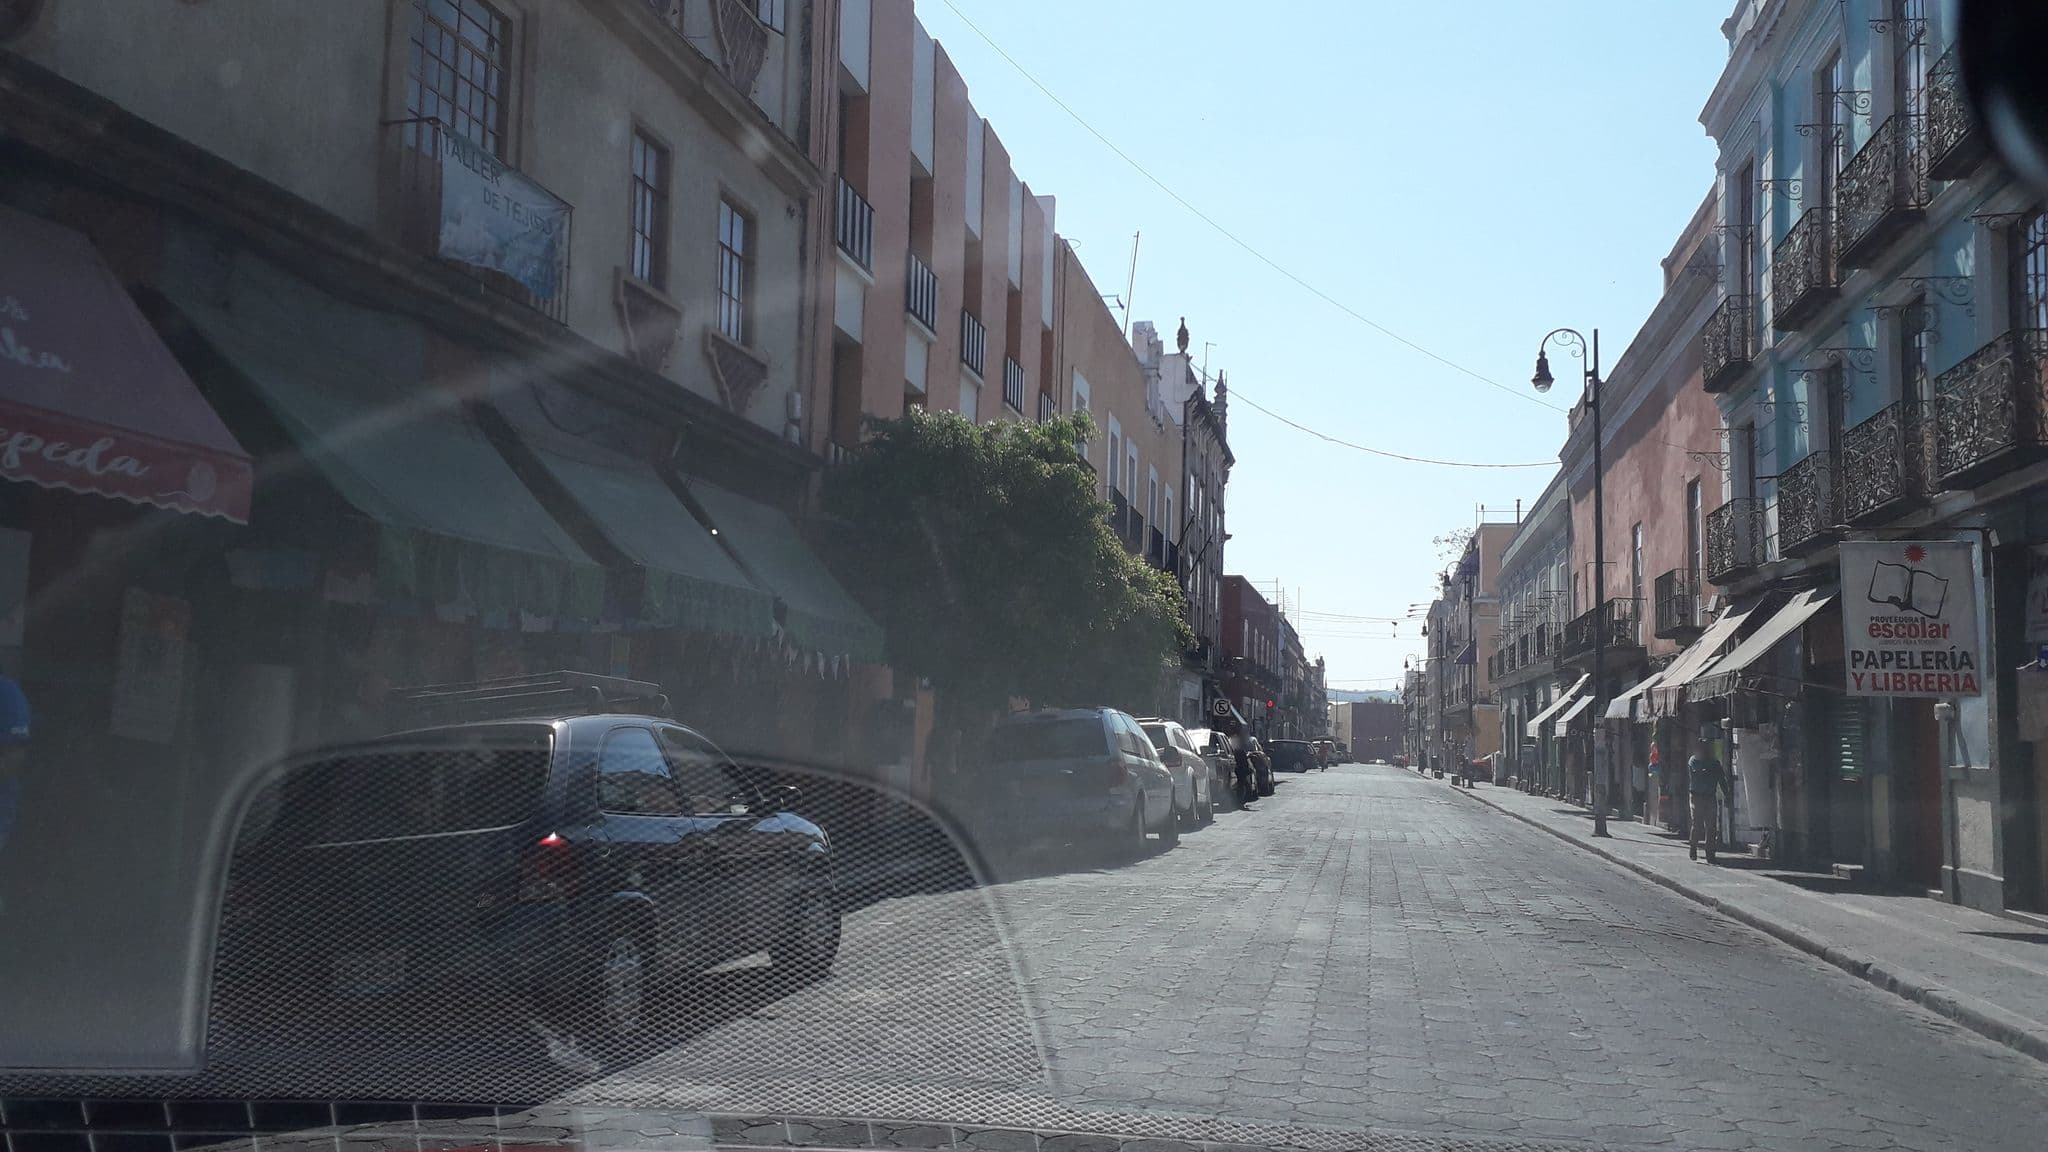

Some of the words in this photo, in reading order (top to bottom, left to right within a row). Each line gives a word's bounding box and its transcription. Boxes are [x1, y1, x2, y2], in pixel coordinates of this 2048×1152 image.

[443, 133, 501, 187] TALLER
[484, 188, 500, 211] DE
[1868, 617, 1951, 639] escolar
[1870, 615, 1920, 624] PROVEEDORA
[1850, 645, 1975, 670] PAPELERÍA
[1851, 672, 1866, 691] Y
